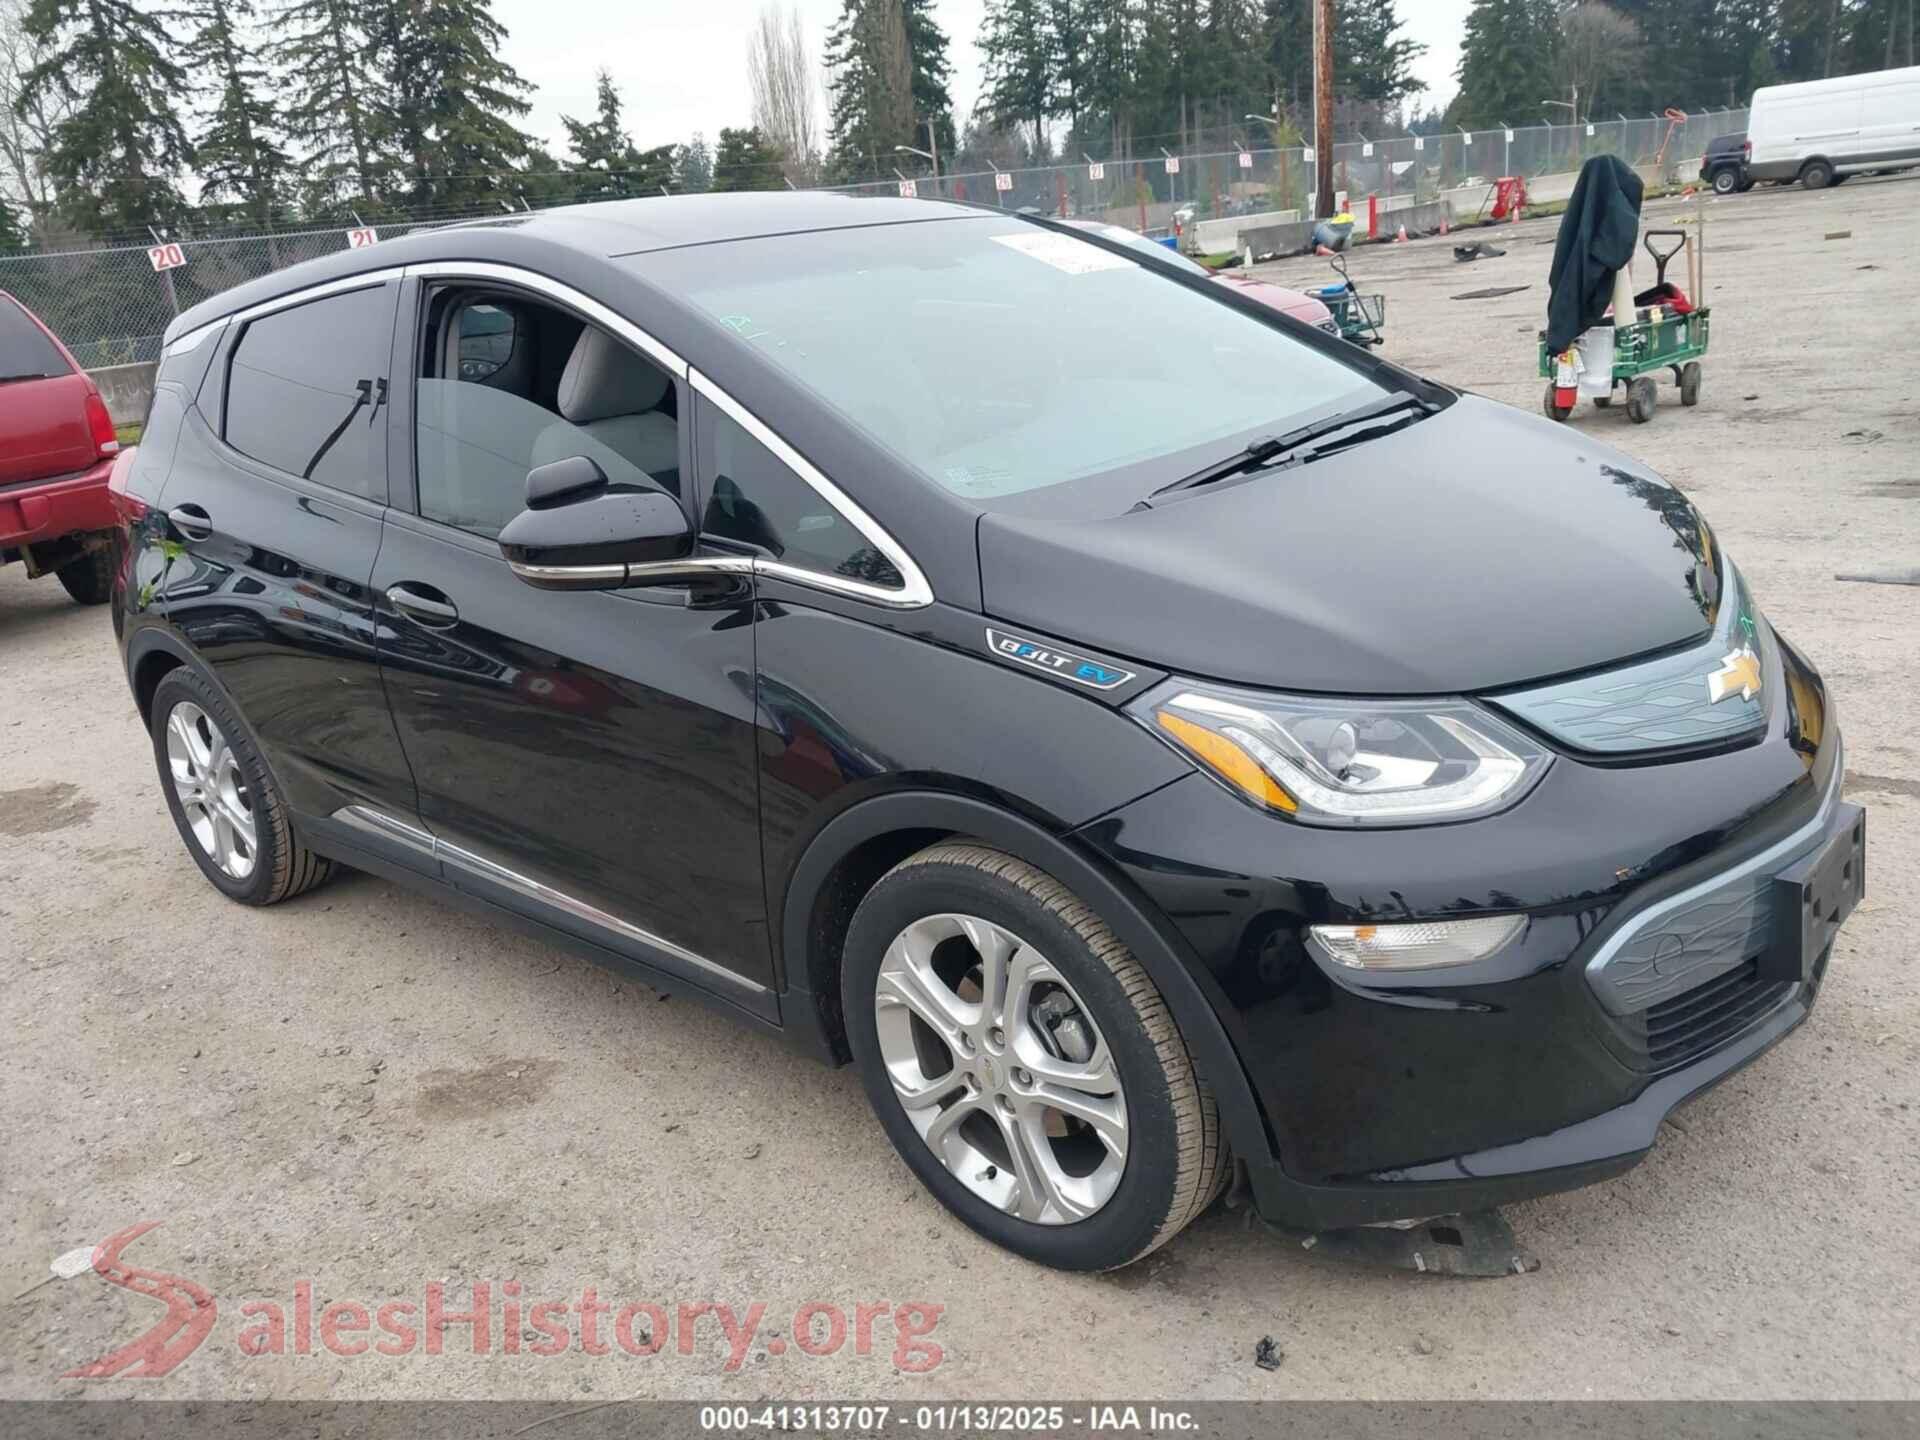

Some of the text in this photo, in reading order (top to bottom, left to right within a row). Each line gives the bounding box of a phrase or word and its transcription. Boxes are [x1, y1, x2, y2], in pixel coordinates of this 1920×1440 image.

[353, 230, 372, 248] 21
[152, 245, 182, 269] 20
[999, 639, 1117, 683] BOLT EV
